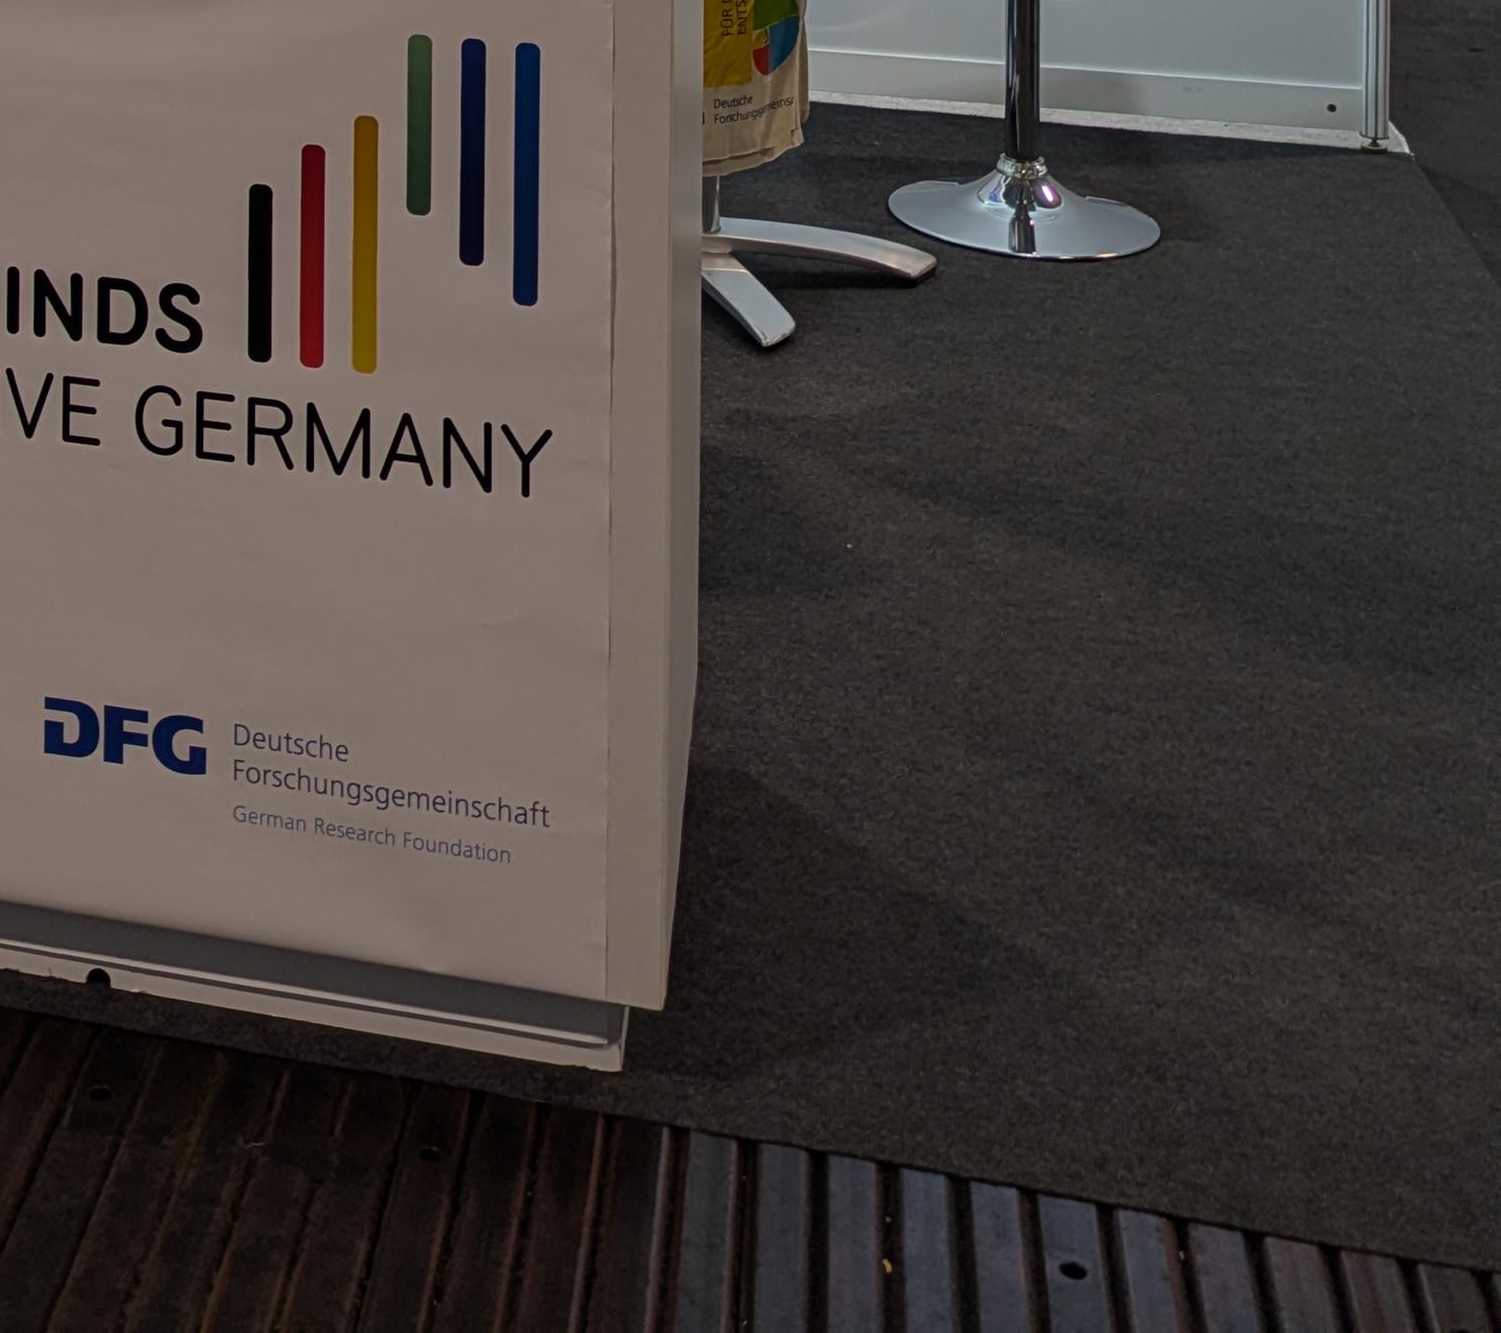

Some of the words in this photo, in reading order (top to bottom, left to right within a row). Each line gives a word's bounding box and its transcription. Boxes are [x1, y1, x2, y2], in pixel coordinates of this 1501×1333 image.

[714, 95, 753, 110] Deutsche
[133, 384, 552, 499] GERMANY
[43, 697, 206, 776] DFG
[233, 725, 349, 762] Deutsche
[233, 759, 550, 829] Forschungsgemeinschaft
[233, 806, 307, 834] German
[313, 815, 396, 846] Research
[401, 830, 511, 864] Foundation
